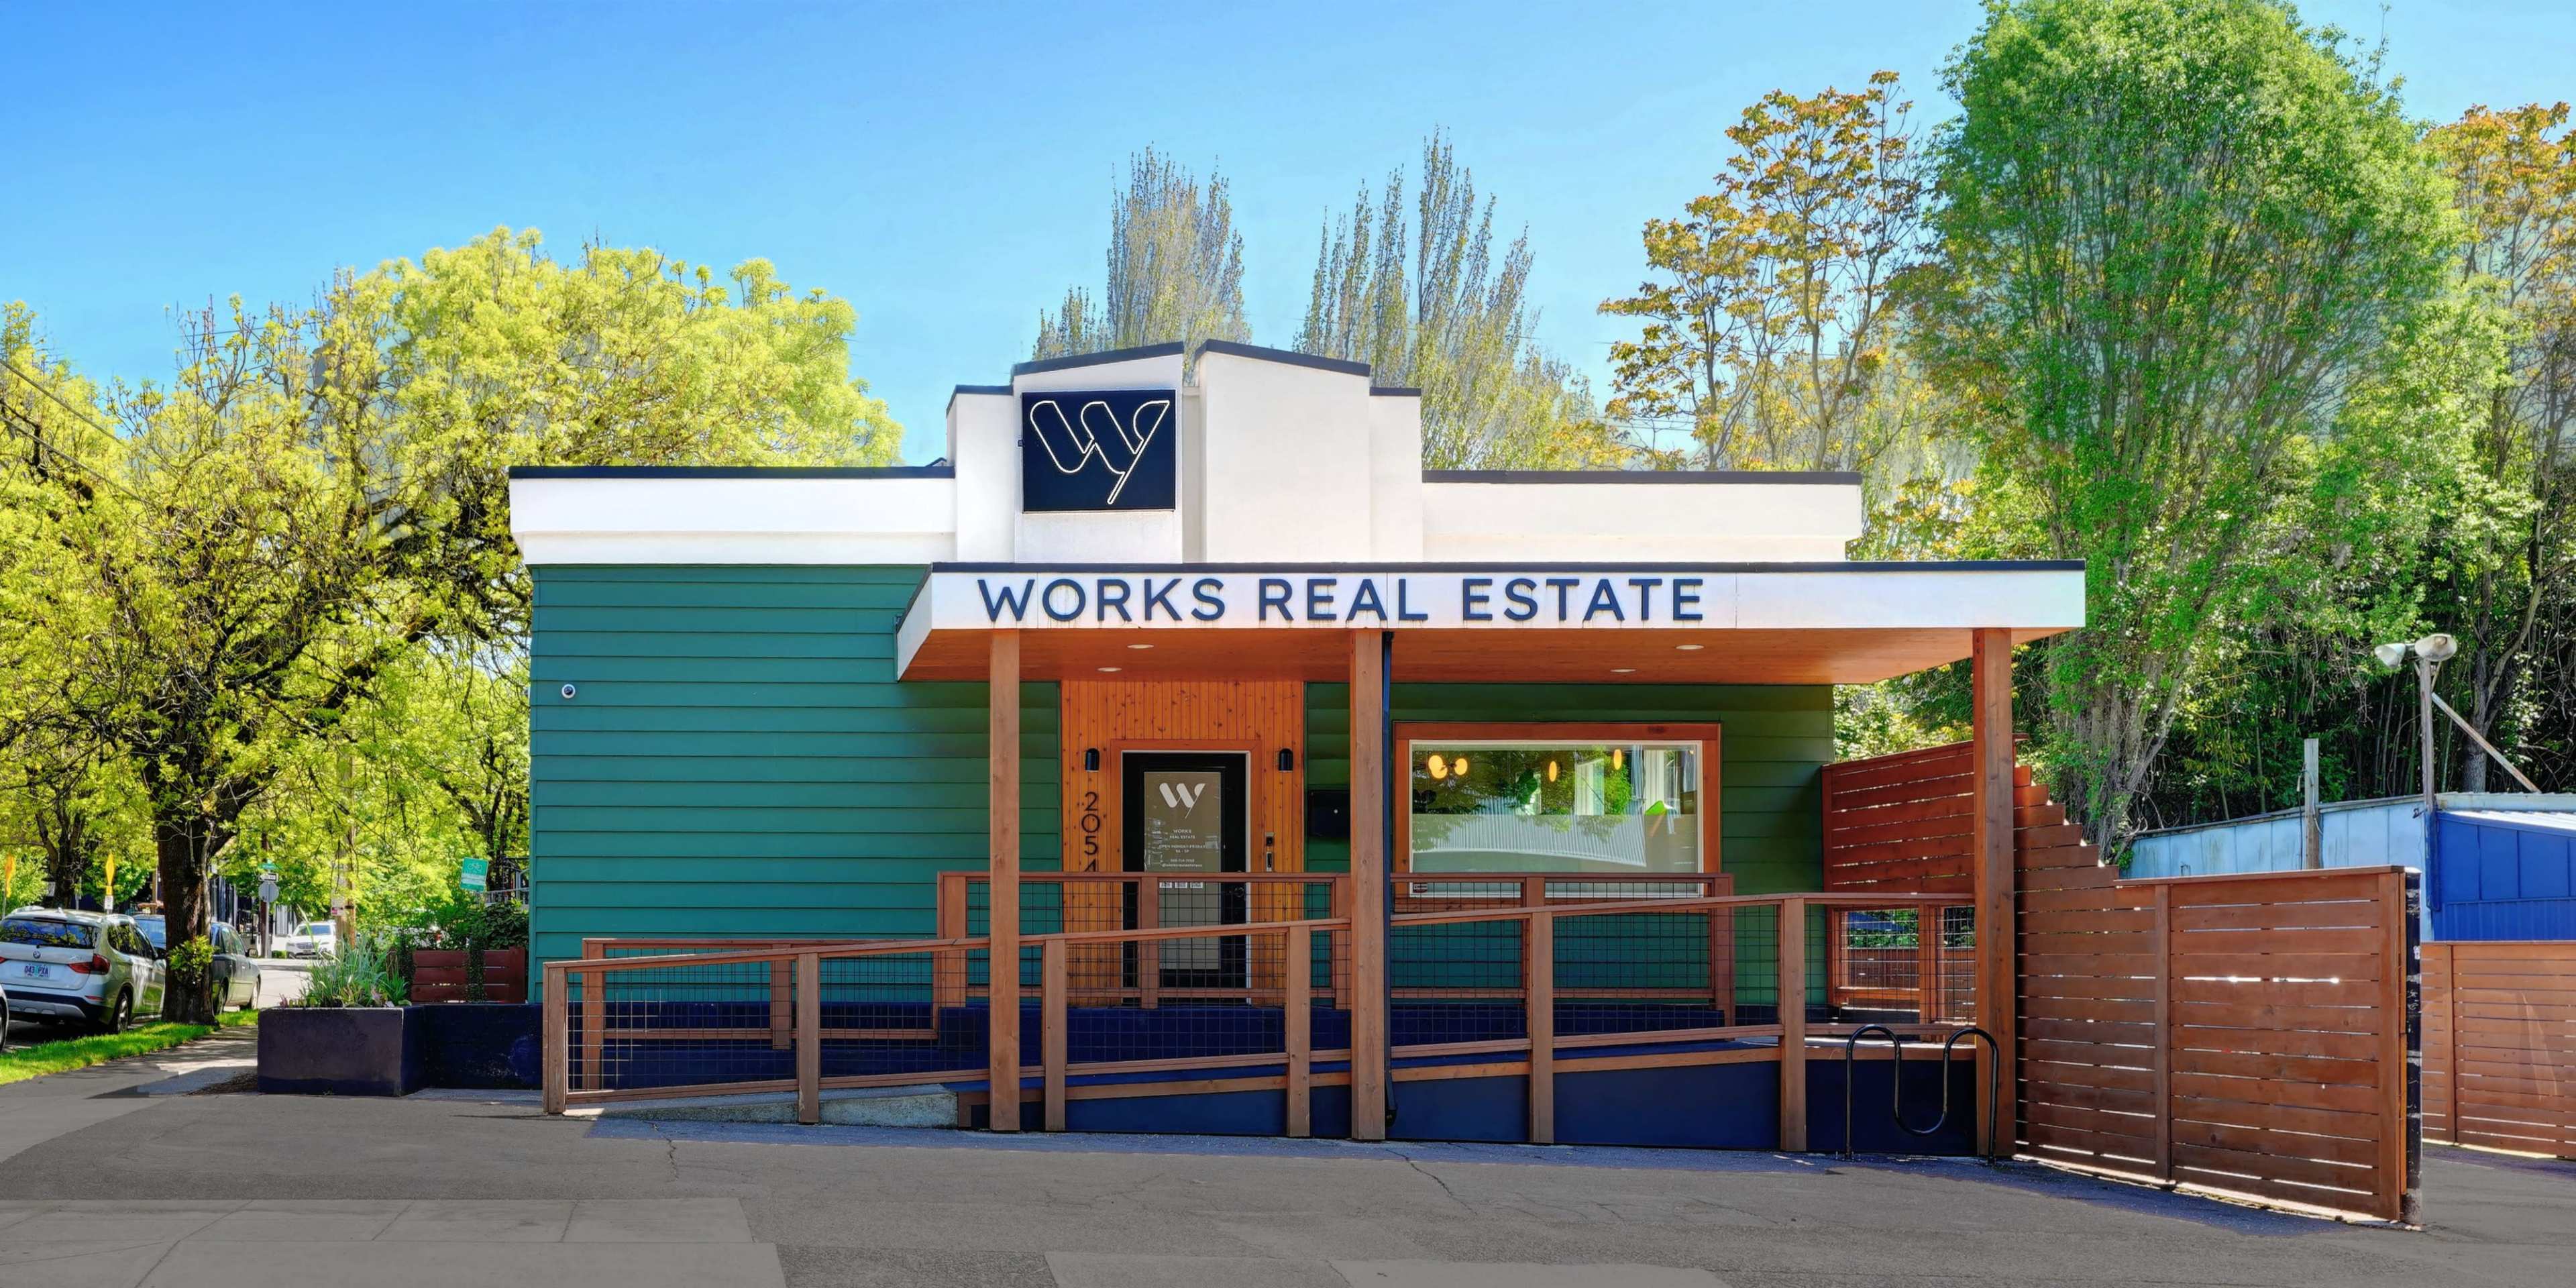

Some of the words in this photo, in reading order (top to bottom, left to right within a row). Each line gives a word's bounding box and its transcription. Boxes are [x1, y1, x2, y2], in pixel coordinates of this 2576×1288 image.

[977, 578, 1226, 623] WORKS
[1258, 578, 1428, 621] REAL
[1462, 578, 1703, 621] ESTATE
